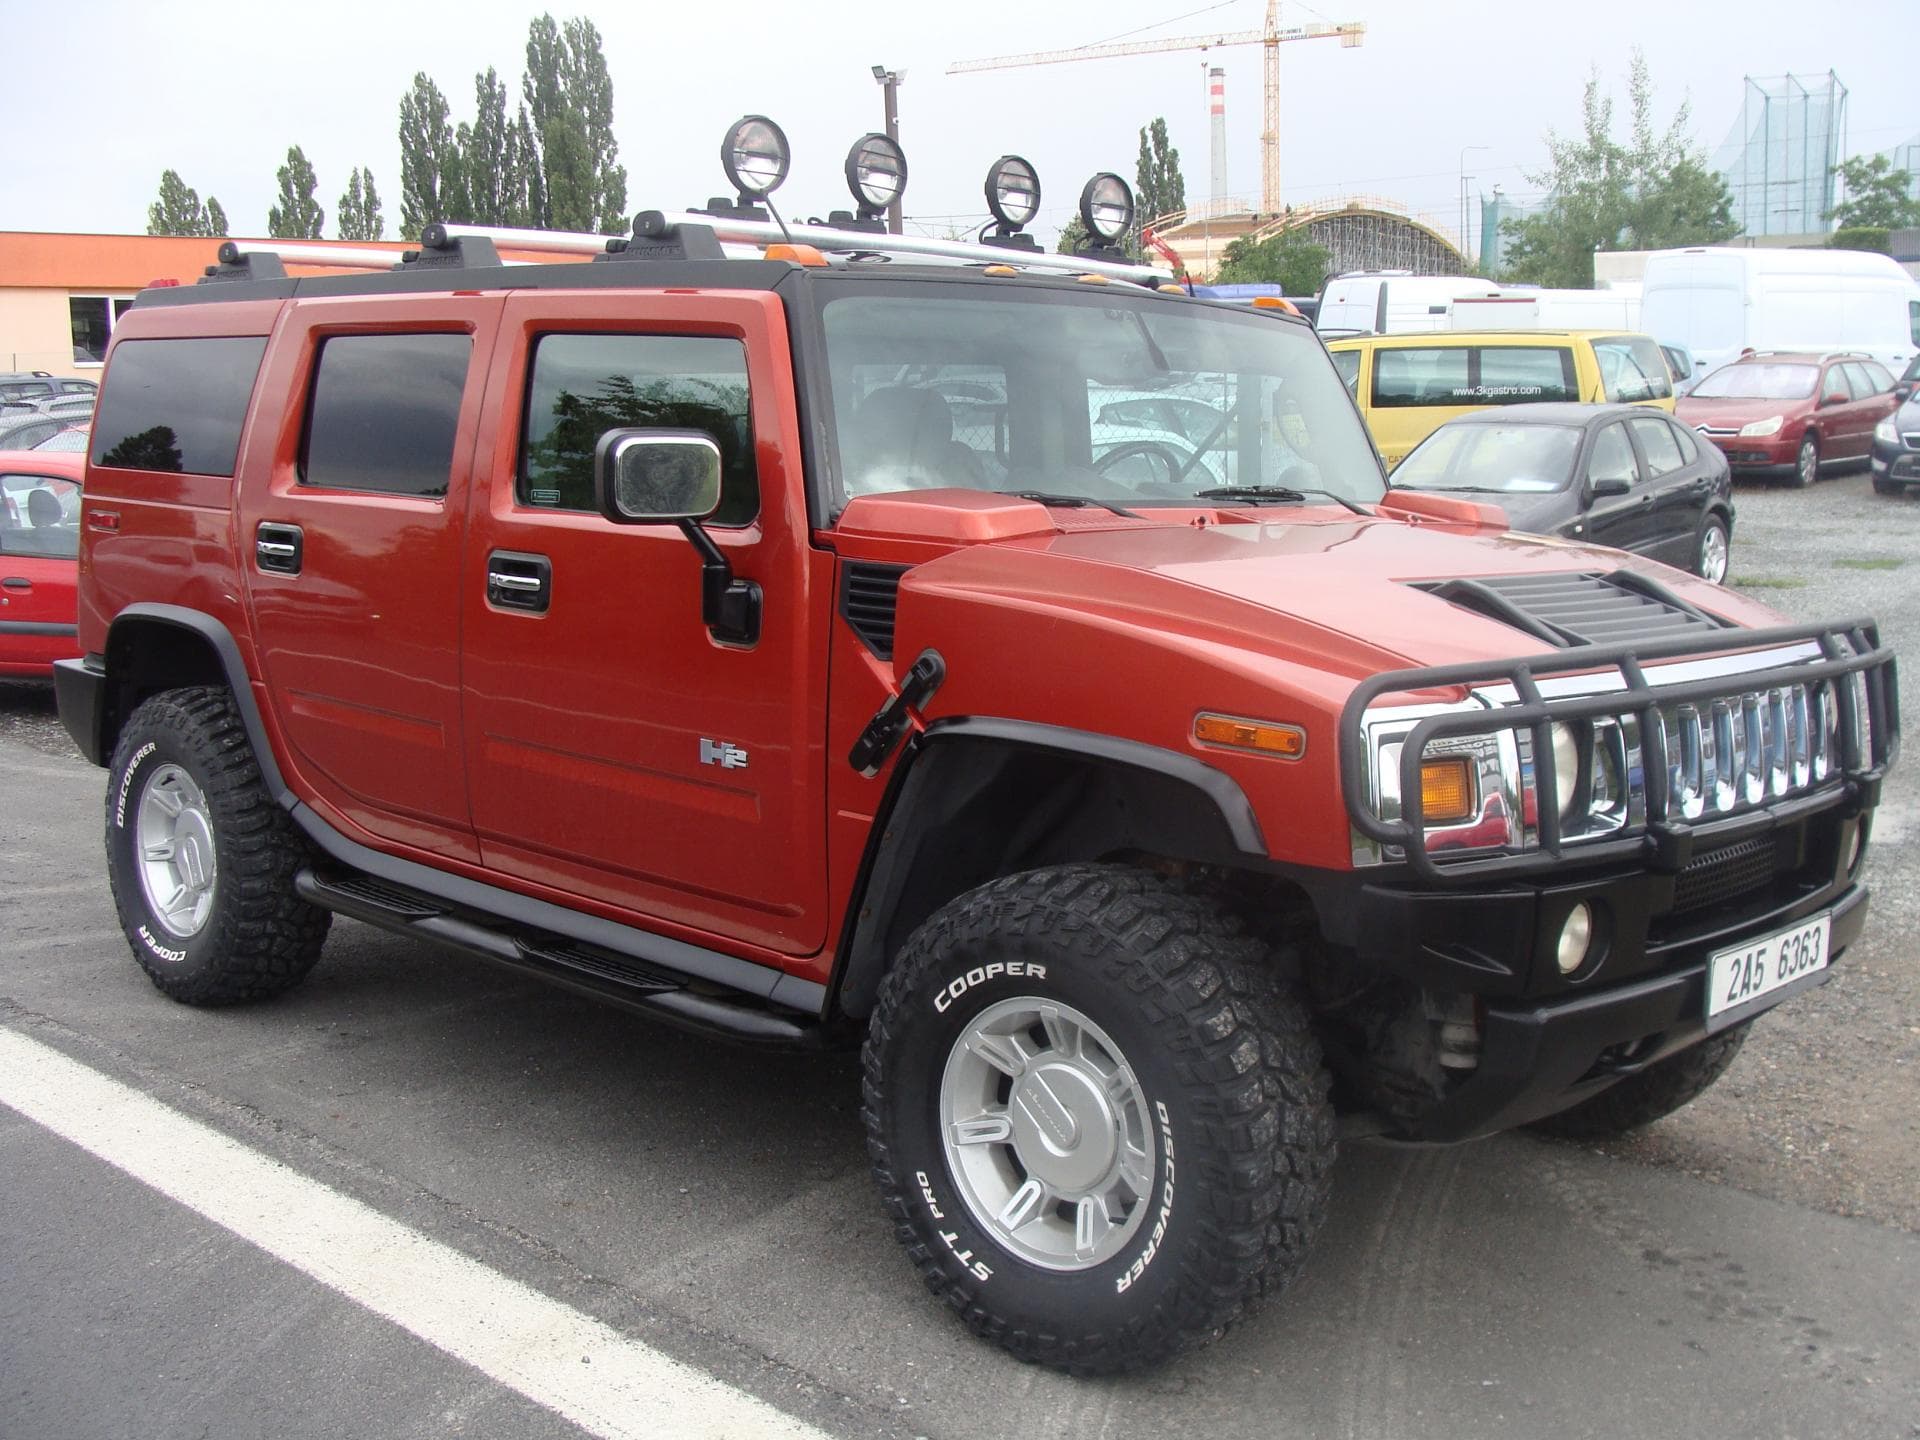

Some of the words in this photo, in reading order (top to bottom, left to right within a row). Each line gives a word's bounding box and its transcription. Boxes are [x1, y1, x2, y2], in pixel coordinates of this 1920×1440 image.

[1452, 385, 1542, 398] www.3kgastro.com
[700, 738, 747, 769] H2
[116, 741, 157, 829] DISCOVERER
[138, 925, 187, 963] COOPER
[1727, 947, 1768, 1002] 2A5
[1777, 925, 1822, 980] 6363
[934, 962, 1047, 1013] COOPER
[916, 1170, 945, 1219] PRO
[1116, 1100, 1176, 1294] DISCOVERER
[938, 1229, 995, 1282] STT
